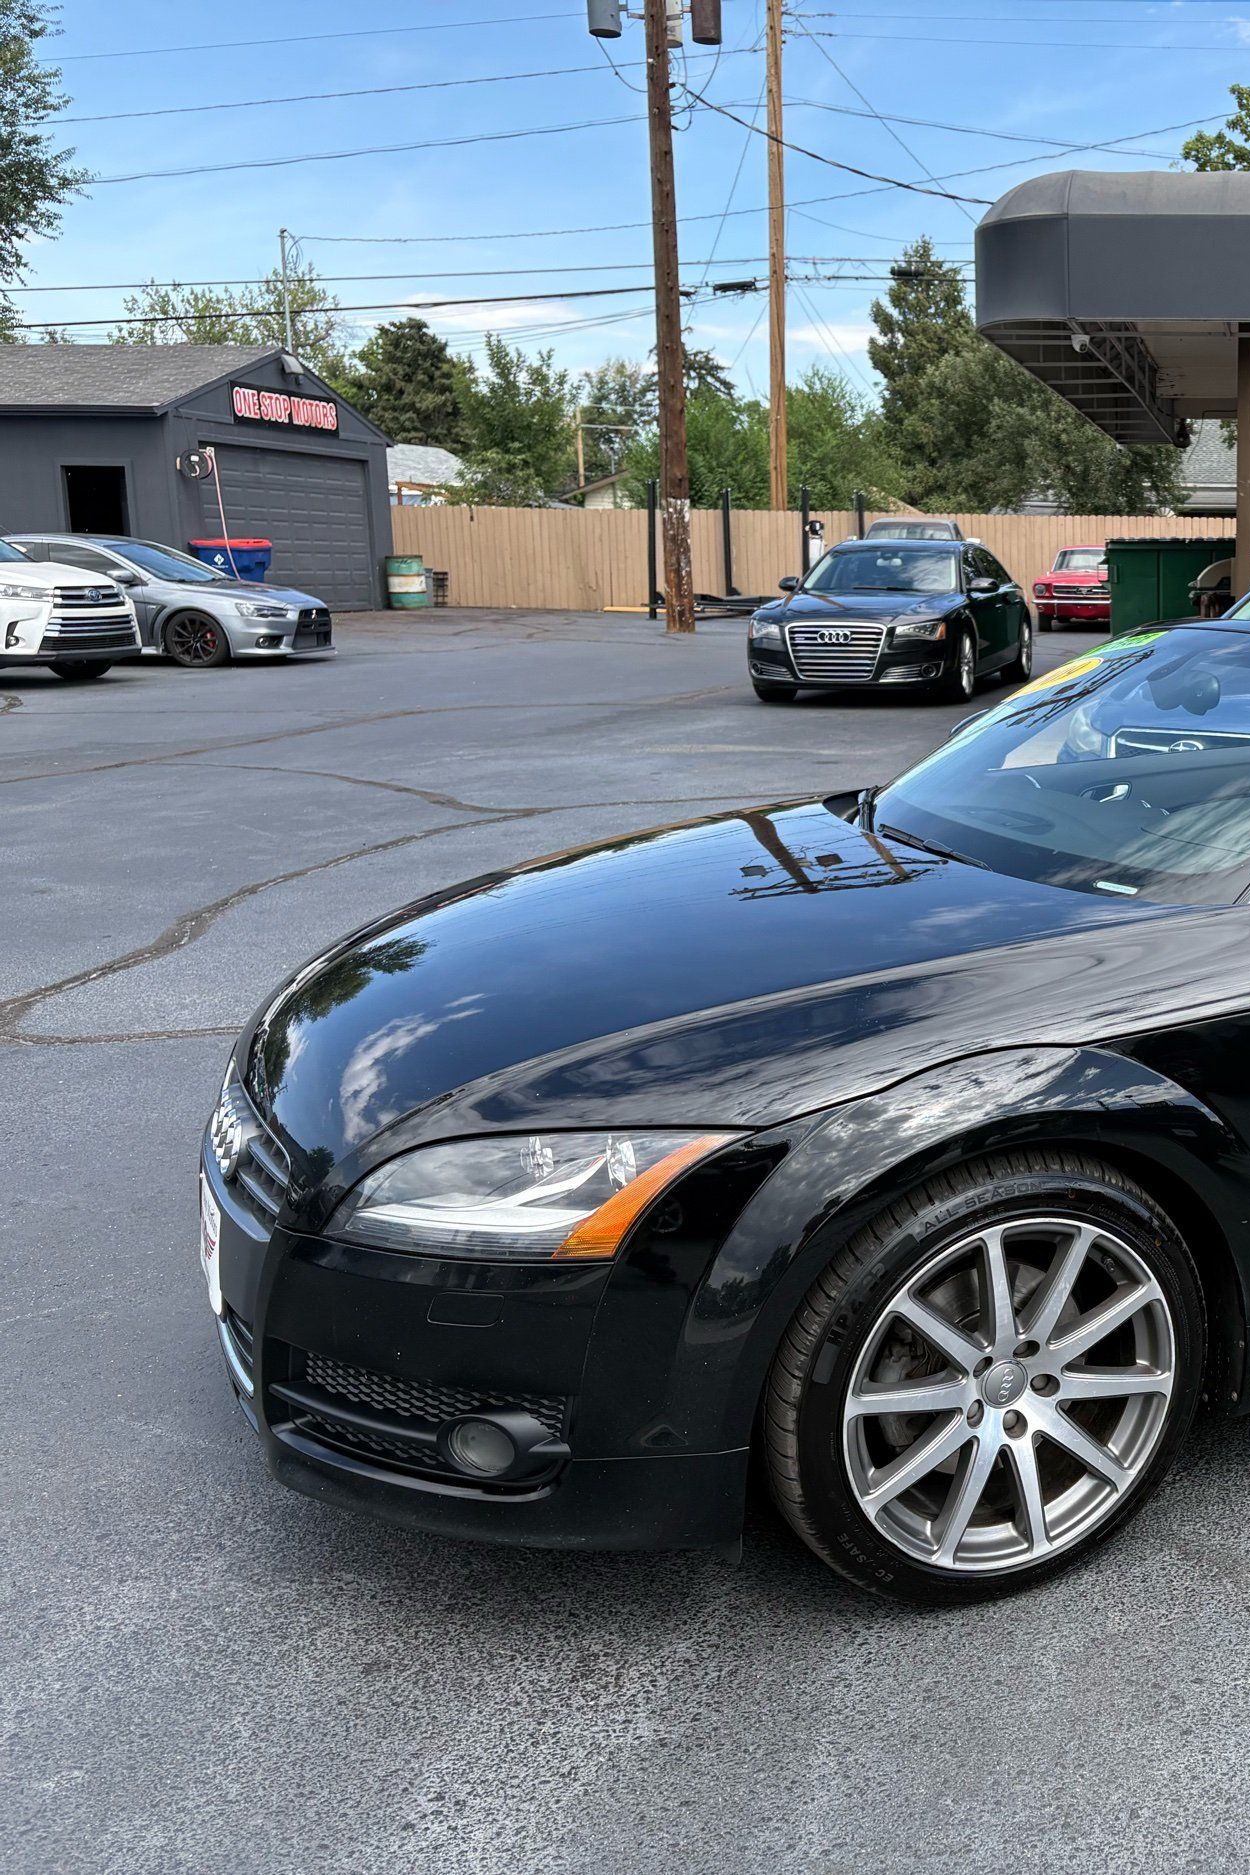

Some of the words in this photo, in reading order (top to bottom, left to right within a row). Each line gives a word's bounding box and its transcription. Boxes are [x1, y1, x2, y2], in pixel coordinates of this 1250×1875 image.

[233, 387, 260, 419] ONE
[260, 391, 290, 424] STOP
[290, 396, 337, 431] MOTORS
[923, 1207, 961, 1233] ALL
[963, 1181, 1043, 1209] SEASON
